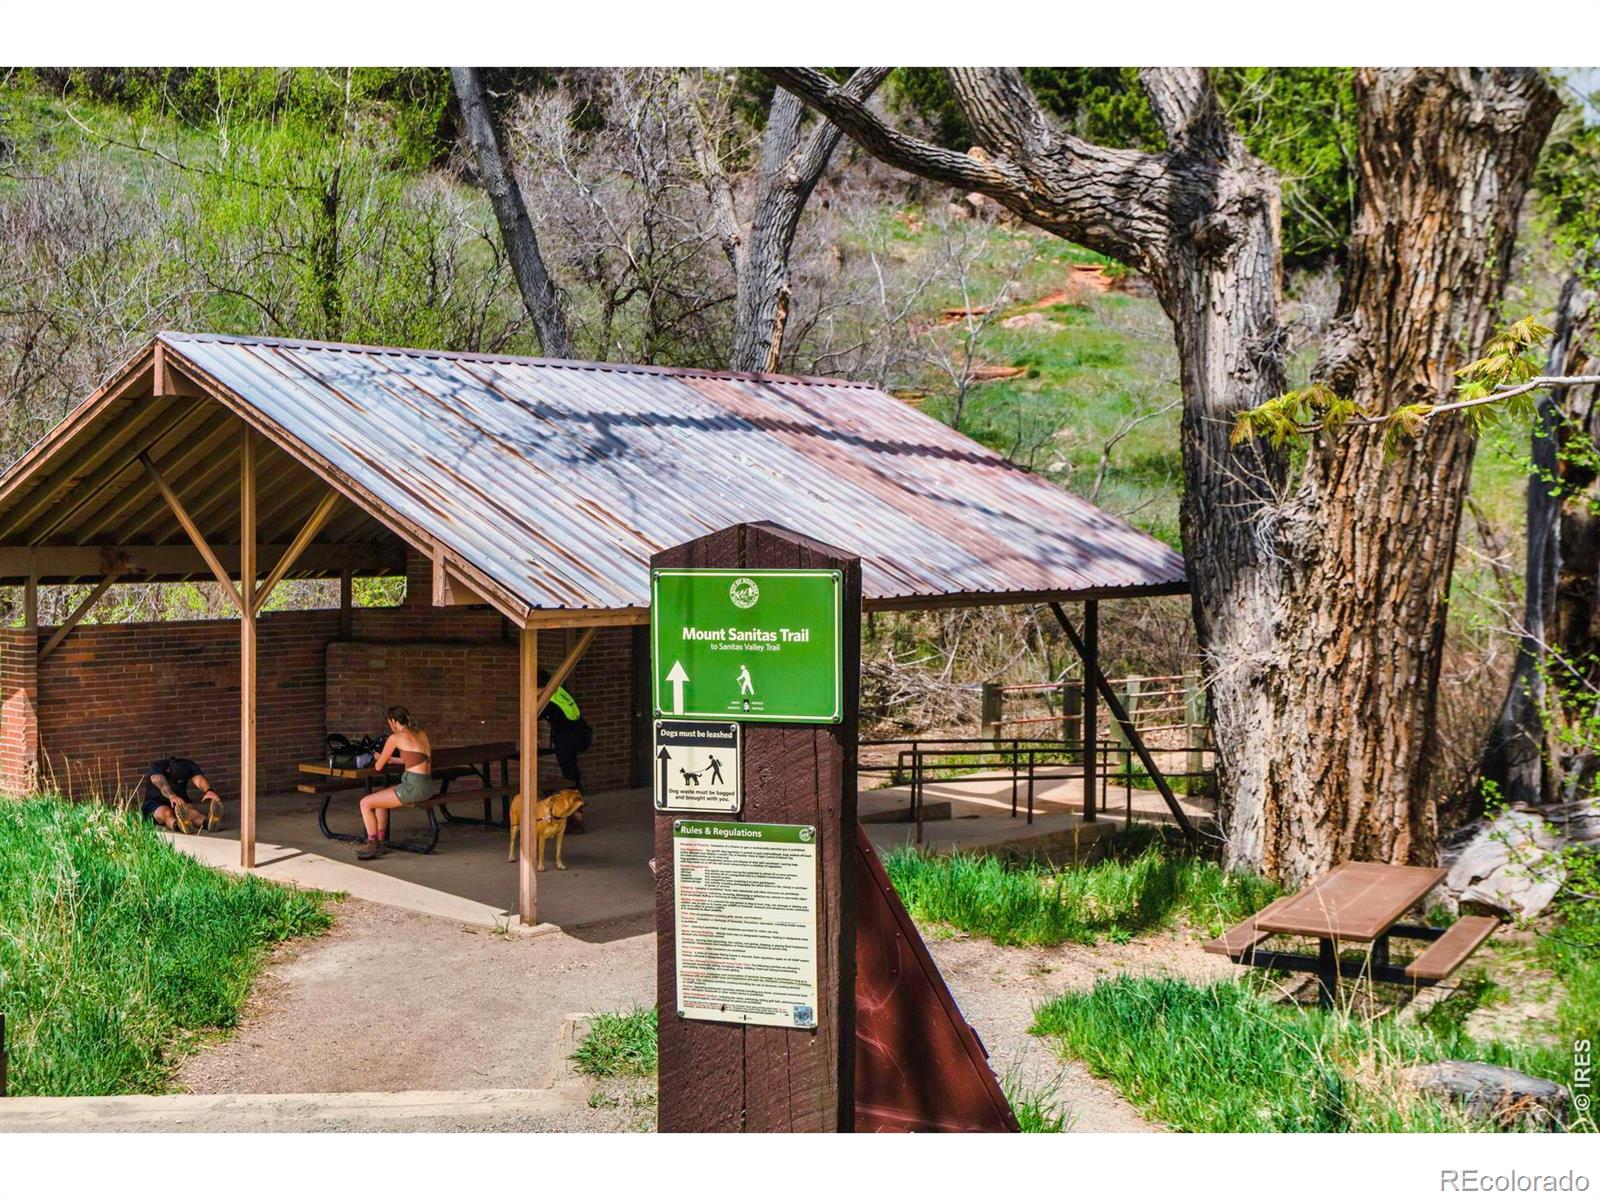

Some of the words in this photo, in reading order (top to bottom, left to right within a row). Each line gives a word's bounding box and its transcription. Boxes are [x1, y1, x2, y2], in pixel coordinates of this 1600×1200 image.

[682, 627, 726, 641] Mount
[728, 628, 777, 642] Sanitas
[779, 628, 810, 642] Trail
[719, 643, 743, 651] Sanitas
[744, 643, 764, 652] Valley
[766, 643, 781, 651] Trail
[660, 729, 678, 738] Dogs
[697, 730, 706, 738] be
[706, 730, 733, 739] leashed
[680, 825, 703, 835] Rules
[704, 827, 712, 835] &
[713, 827, 762, 838] Regulations
